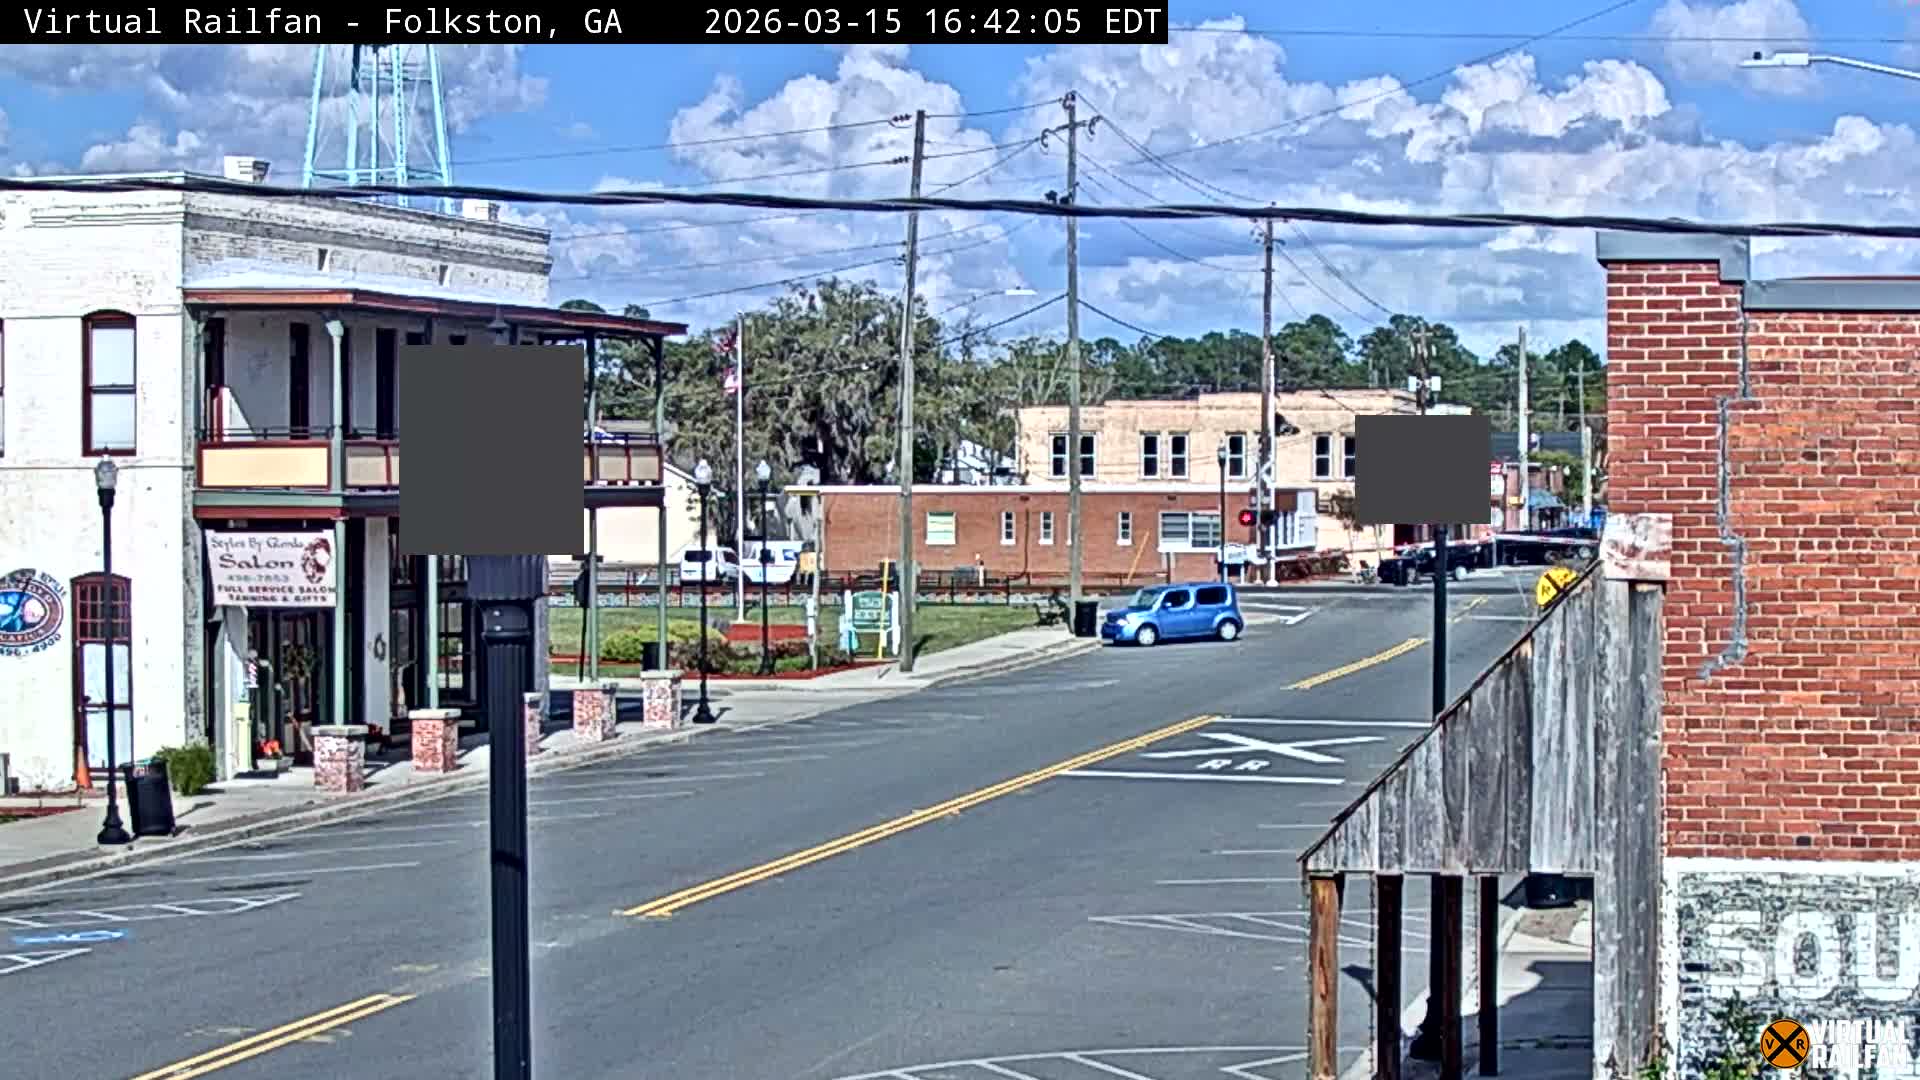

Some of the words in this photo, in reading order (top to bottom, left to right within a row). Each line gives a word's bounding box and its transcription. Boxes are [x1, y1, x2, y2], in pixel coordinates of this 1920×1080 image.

[248, 537, 263, 552] By
[218, 553, 295, 569] Salon
[248, 585, 294, 594] SERVICE
[299, 585, 336, 594] SALON
